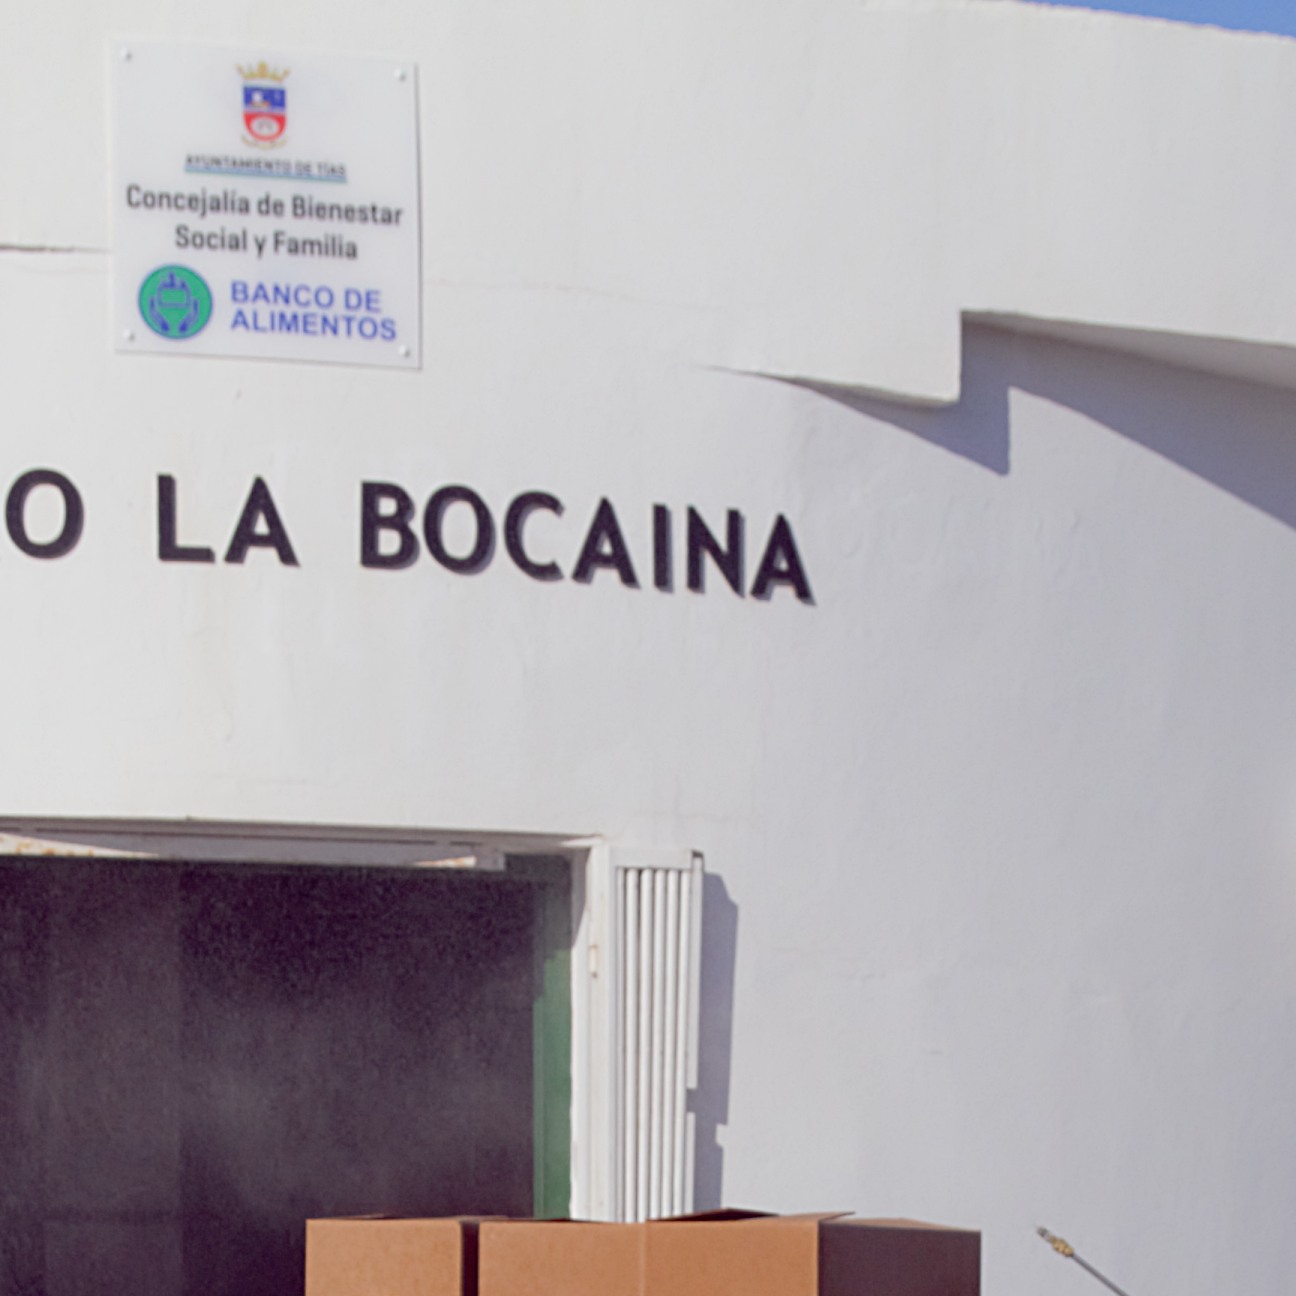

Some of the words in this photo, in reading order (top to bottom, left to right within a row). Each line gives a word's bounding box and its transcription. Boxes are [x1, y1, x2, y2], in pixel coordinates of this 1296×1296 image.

[126, 183, 251, 218] Concejalía
[257, 194, 286, 216] de
[291, 194, 404, 227] Bienestar
[175, 223, 248, 253] Social
[254, 233, 268, 259] y
[272, 229, 359, 260] Familia
[230, 280, 335, 311] BANCO
[344, 287, 382, 313] DE
[230, 309, 398, 342] ALIMENTOS
[156, 474, 300, 568] LA
[360, 480, 818, 606] BOCAINA
